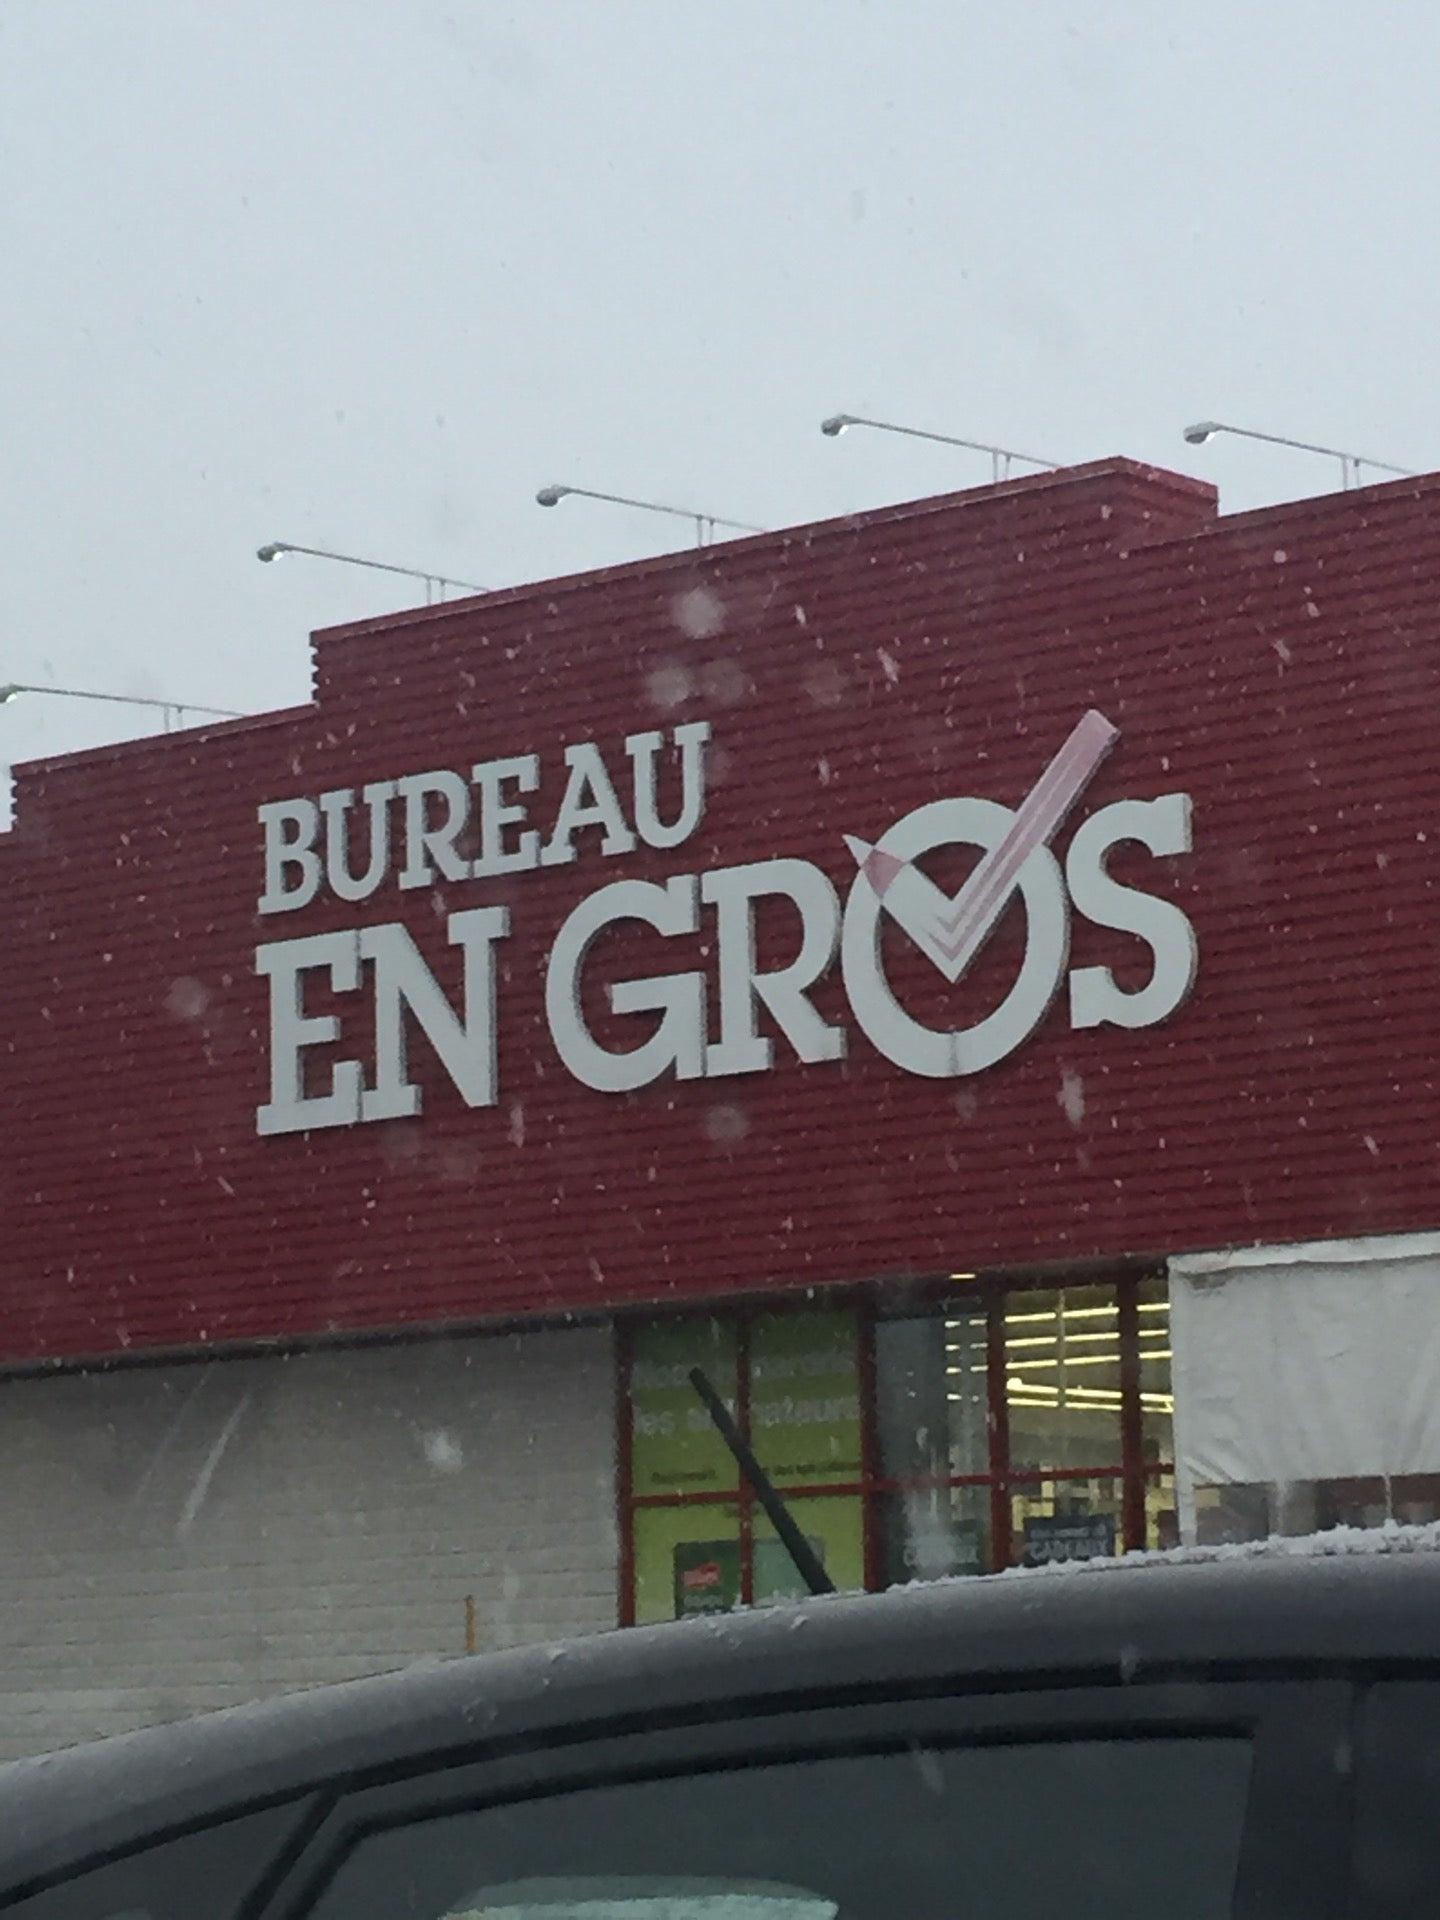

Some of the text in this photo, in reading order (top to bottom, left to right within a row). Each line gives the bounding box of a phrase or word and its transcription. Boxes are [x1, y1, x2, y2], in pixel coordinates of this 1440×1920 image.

[257, 719, 711, 915] BUREAU
[255, 791, 1199, 1136] EN GROS
